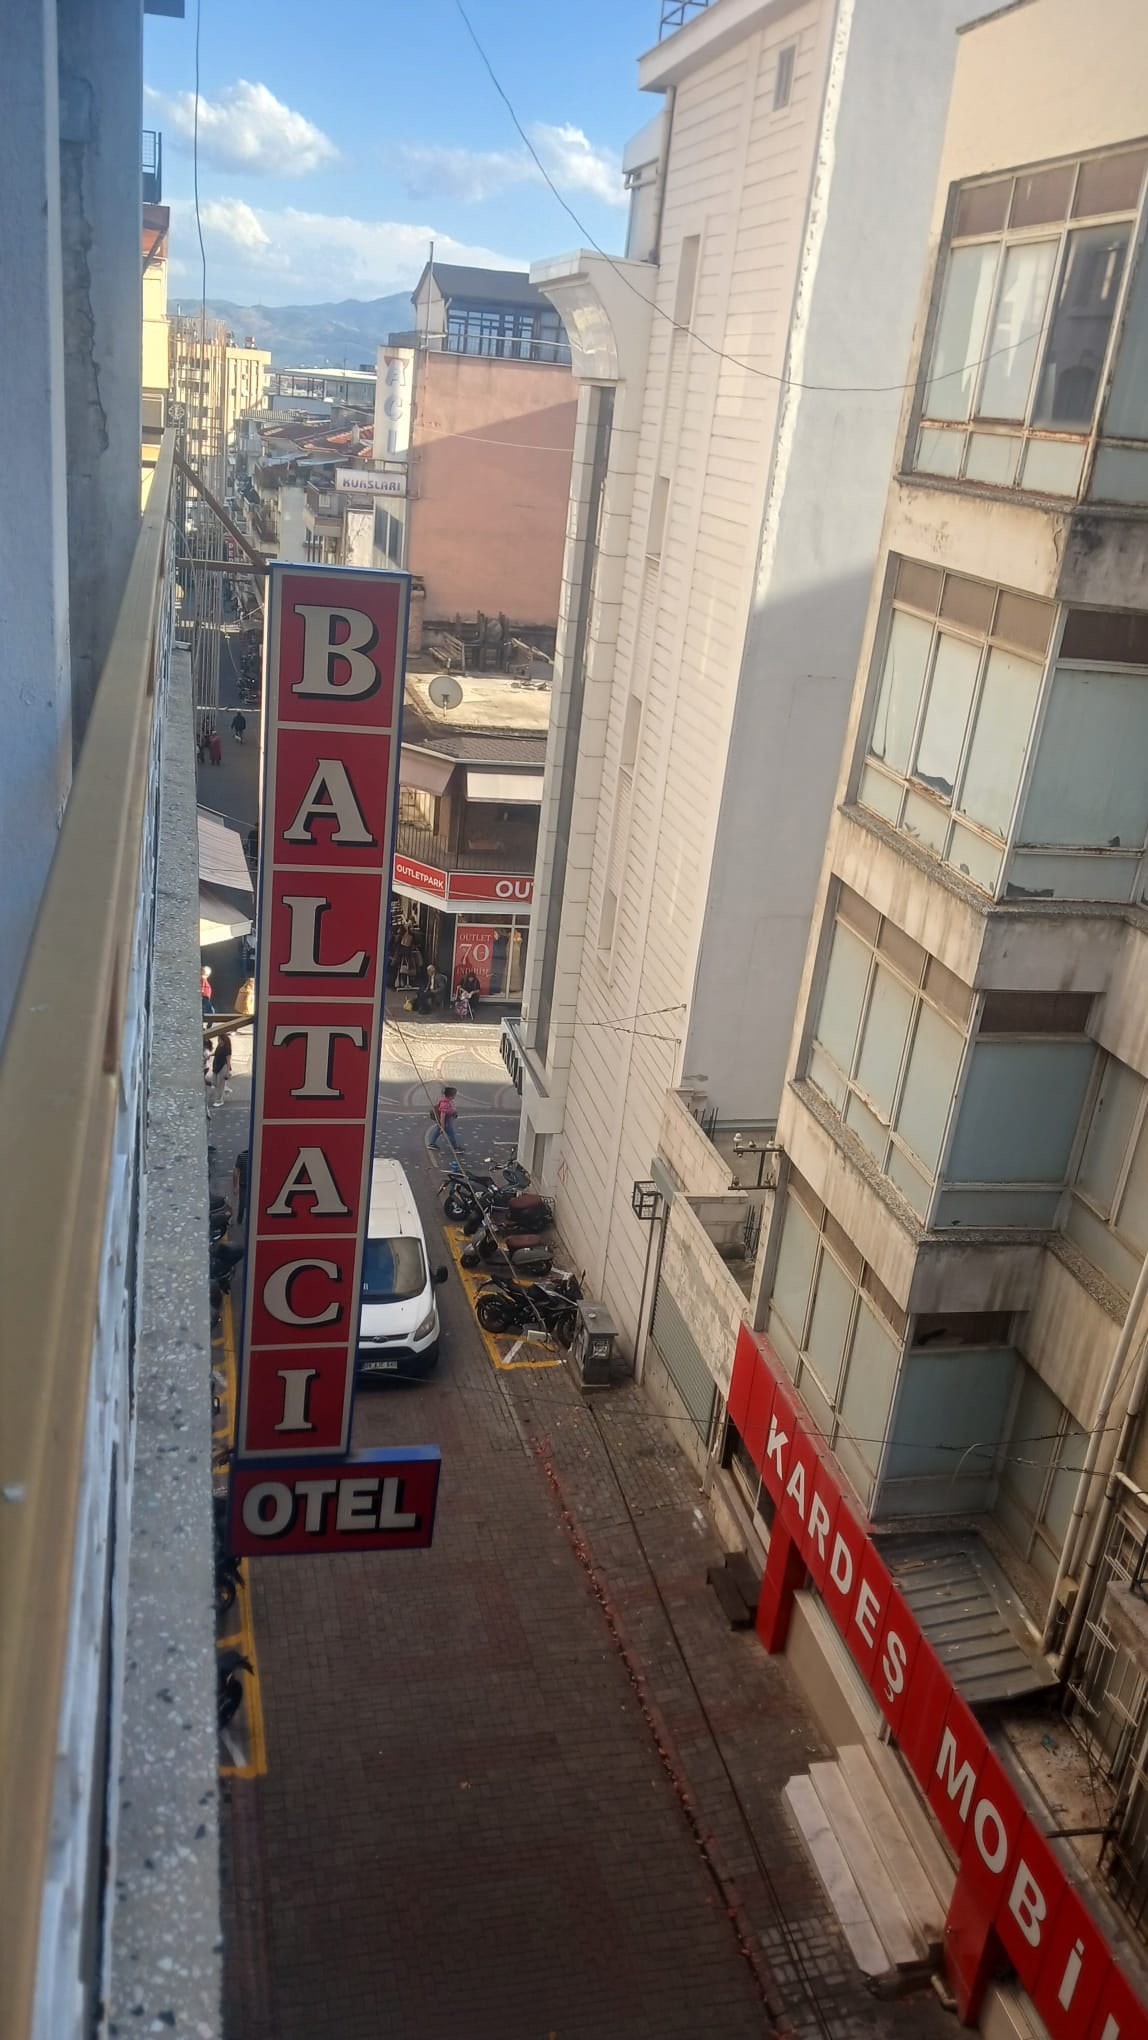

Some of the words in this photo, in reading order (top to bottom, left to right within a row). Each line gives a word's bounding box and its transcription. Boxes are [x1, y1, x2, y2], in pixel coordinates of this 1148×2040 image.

[396, 864, 444, 889] OUTLETPARK
[495, 880, 534, 898] OU
[459, 933, 491, 942] OUTLET
[459, 943, 490, 965] 70
[263, 604, 381, 1432] BALTACI
[242, 1476, 419, 1538] OTEL
[766, 1413, 907, 1703] KARDEŞ
